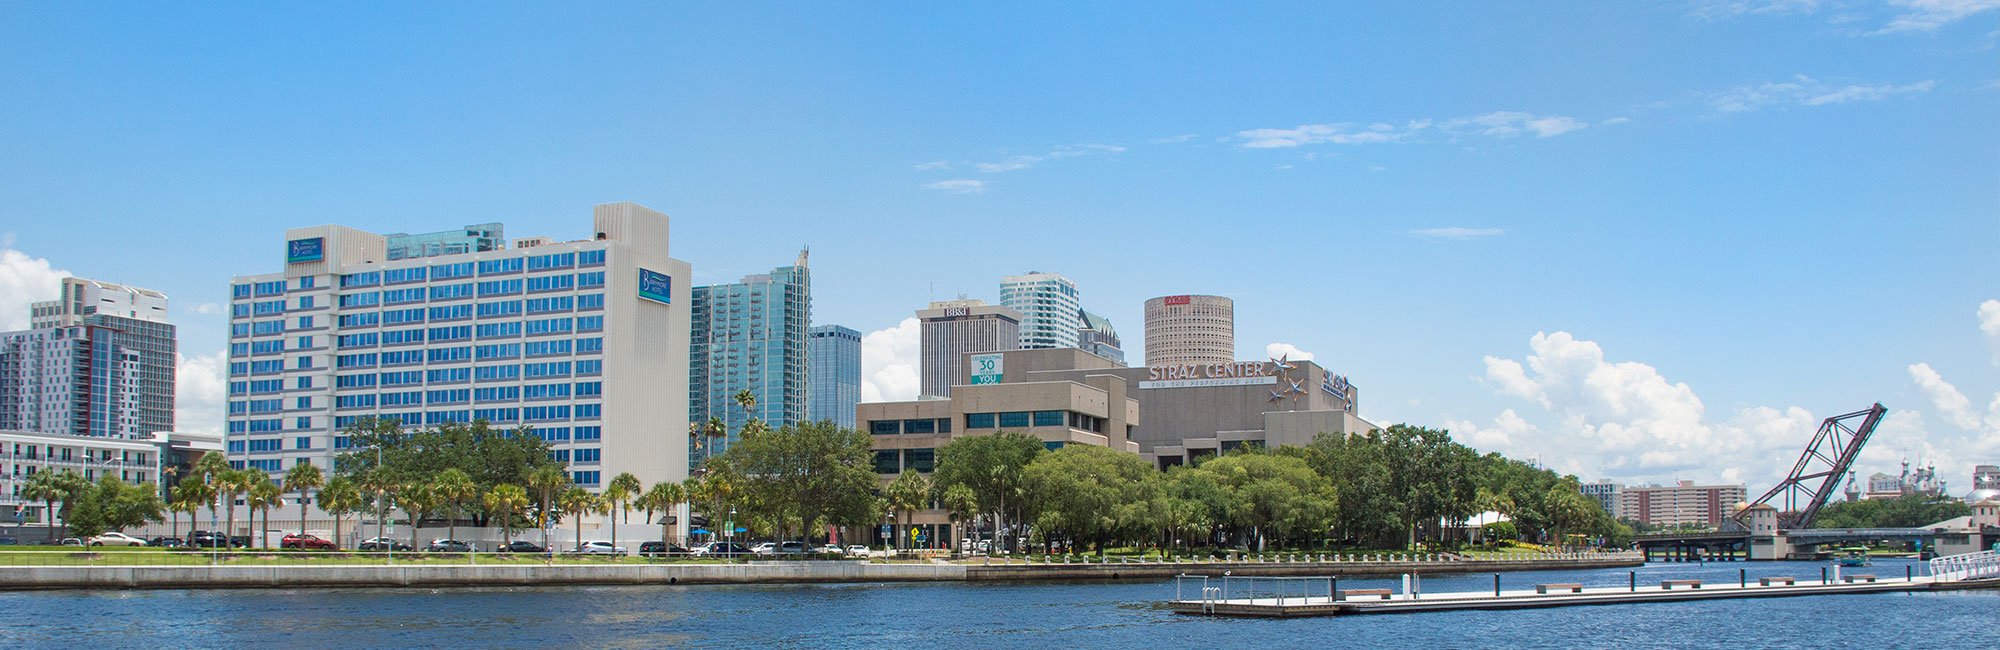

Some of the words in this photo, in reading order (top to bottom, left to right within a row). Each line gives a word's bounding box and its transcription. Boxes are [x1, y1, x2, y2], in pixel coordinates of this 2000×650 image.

[651, 286, 664, 295] HOTEL
[946, 307, 967, 317] BB&T
[980, 359, 995, 371] 30
[1149, 364, 1199, 381] STRAZ
[1205, 361, 1265, 379] CENTER
[979, 375, 997, 383] YOU
